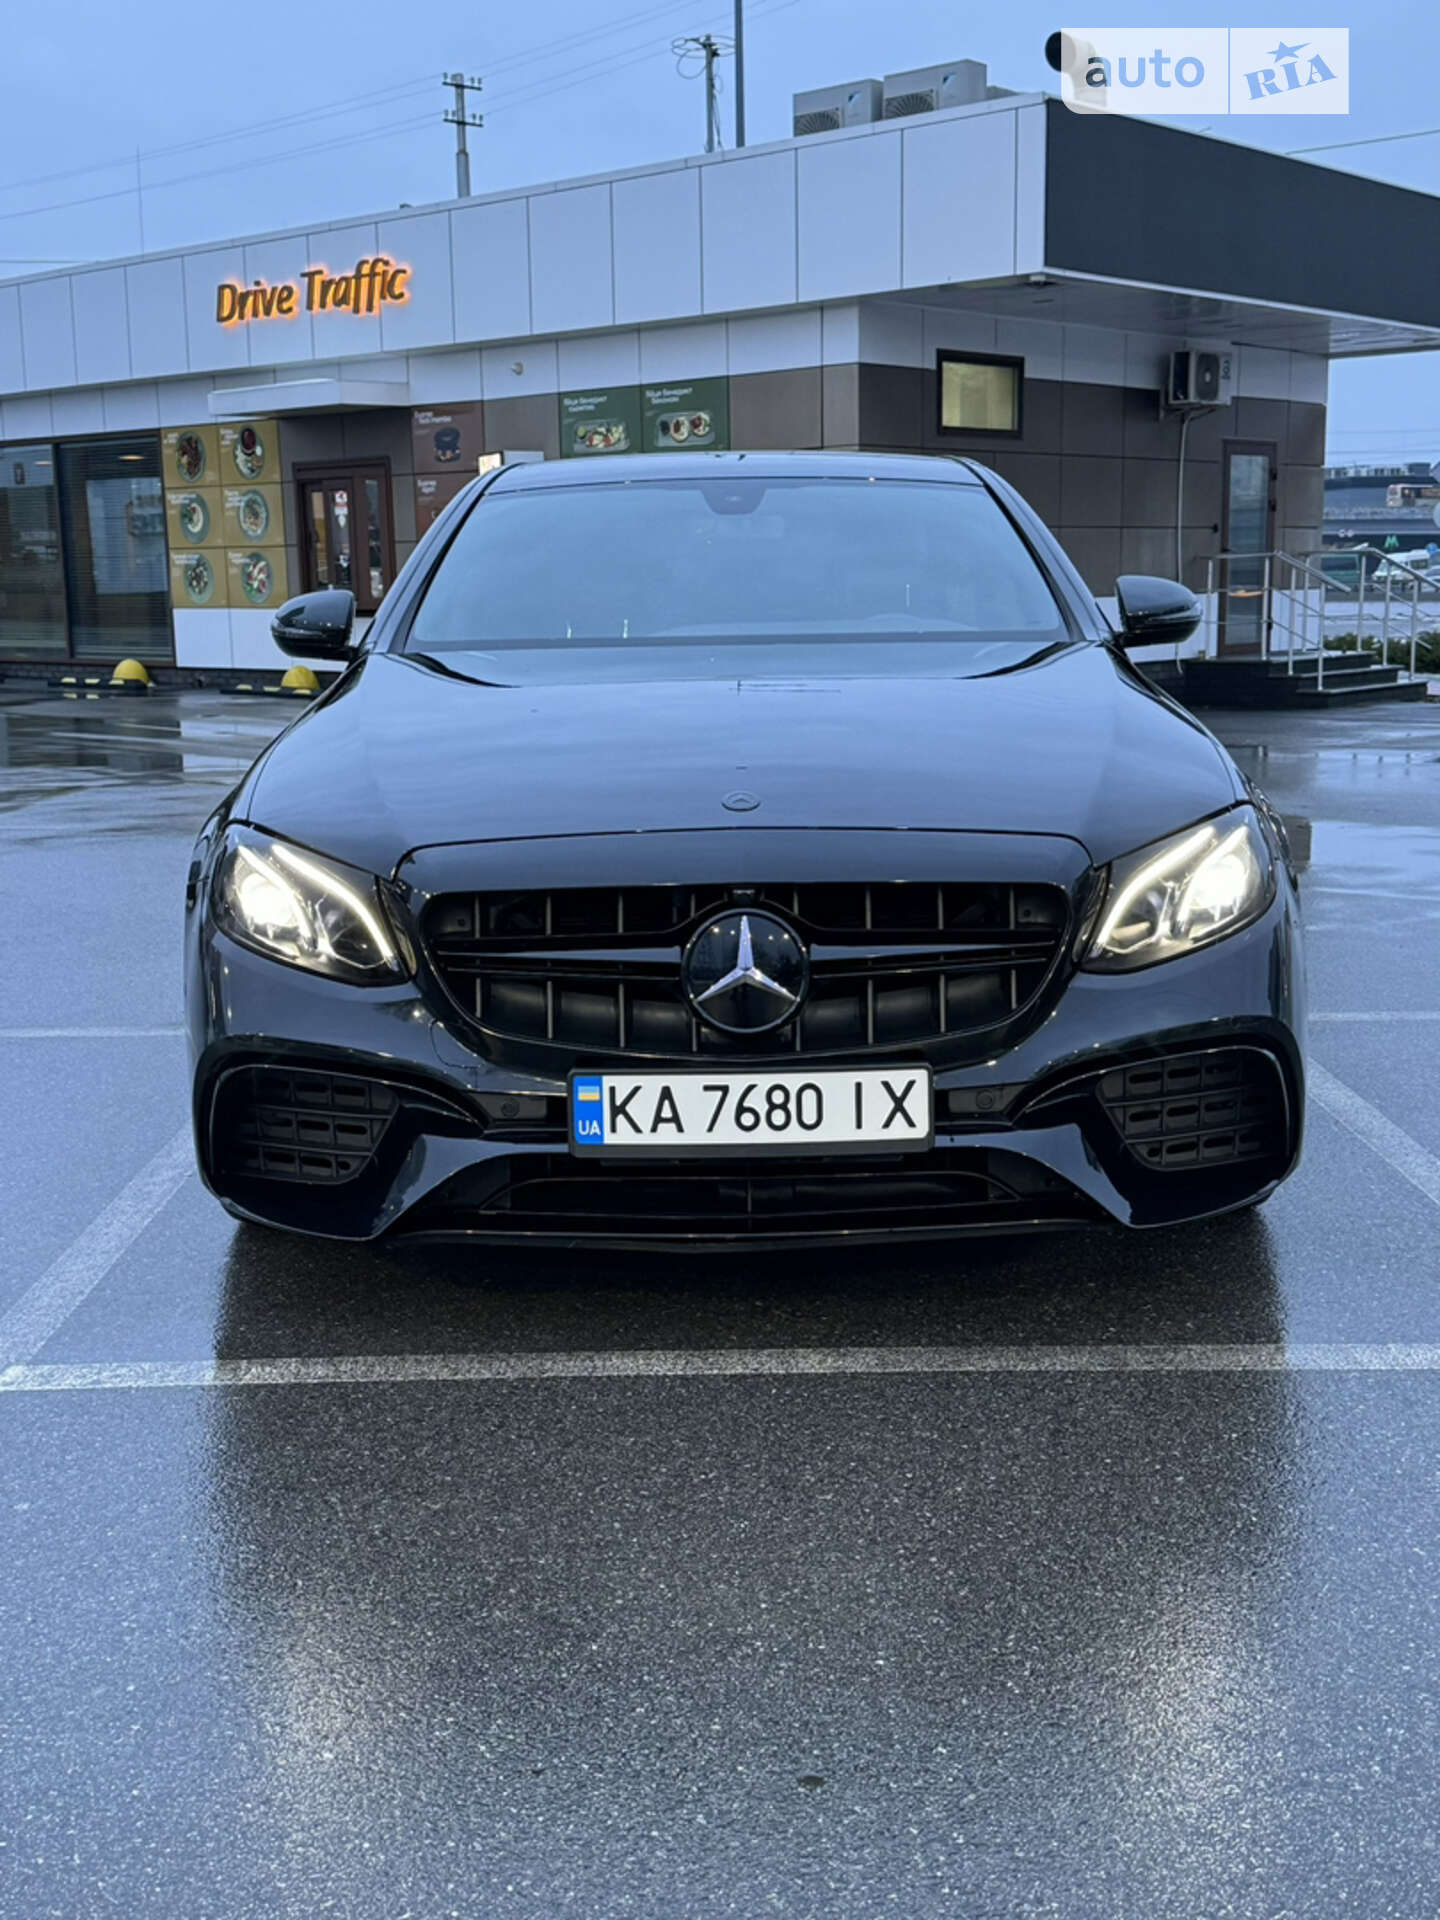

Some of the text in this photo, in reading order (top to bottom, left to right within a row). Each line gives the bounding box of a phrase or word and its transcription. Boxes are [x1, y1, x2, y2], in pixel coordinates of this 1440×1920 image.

[216, 257, 408, 323] Drive Traffic
[578, 1120, 602, 1136] UA
[608, 1079, 917, 1134] KA 7680 IX
